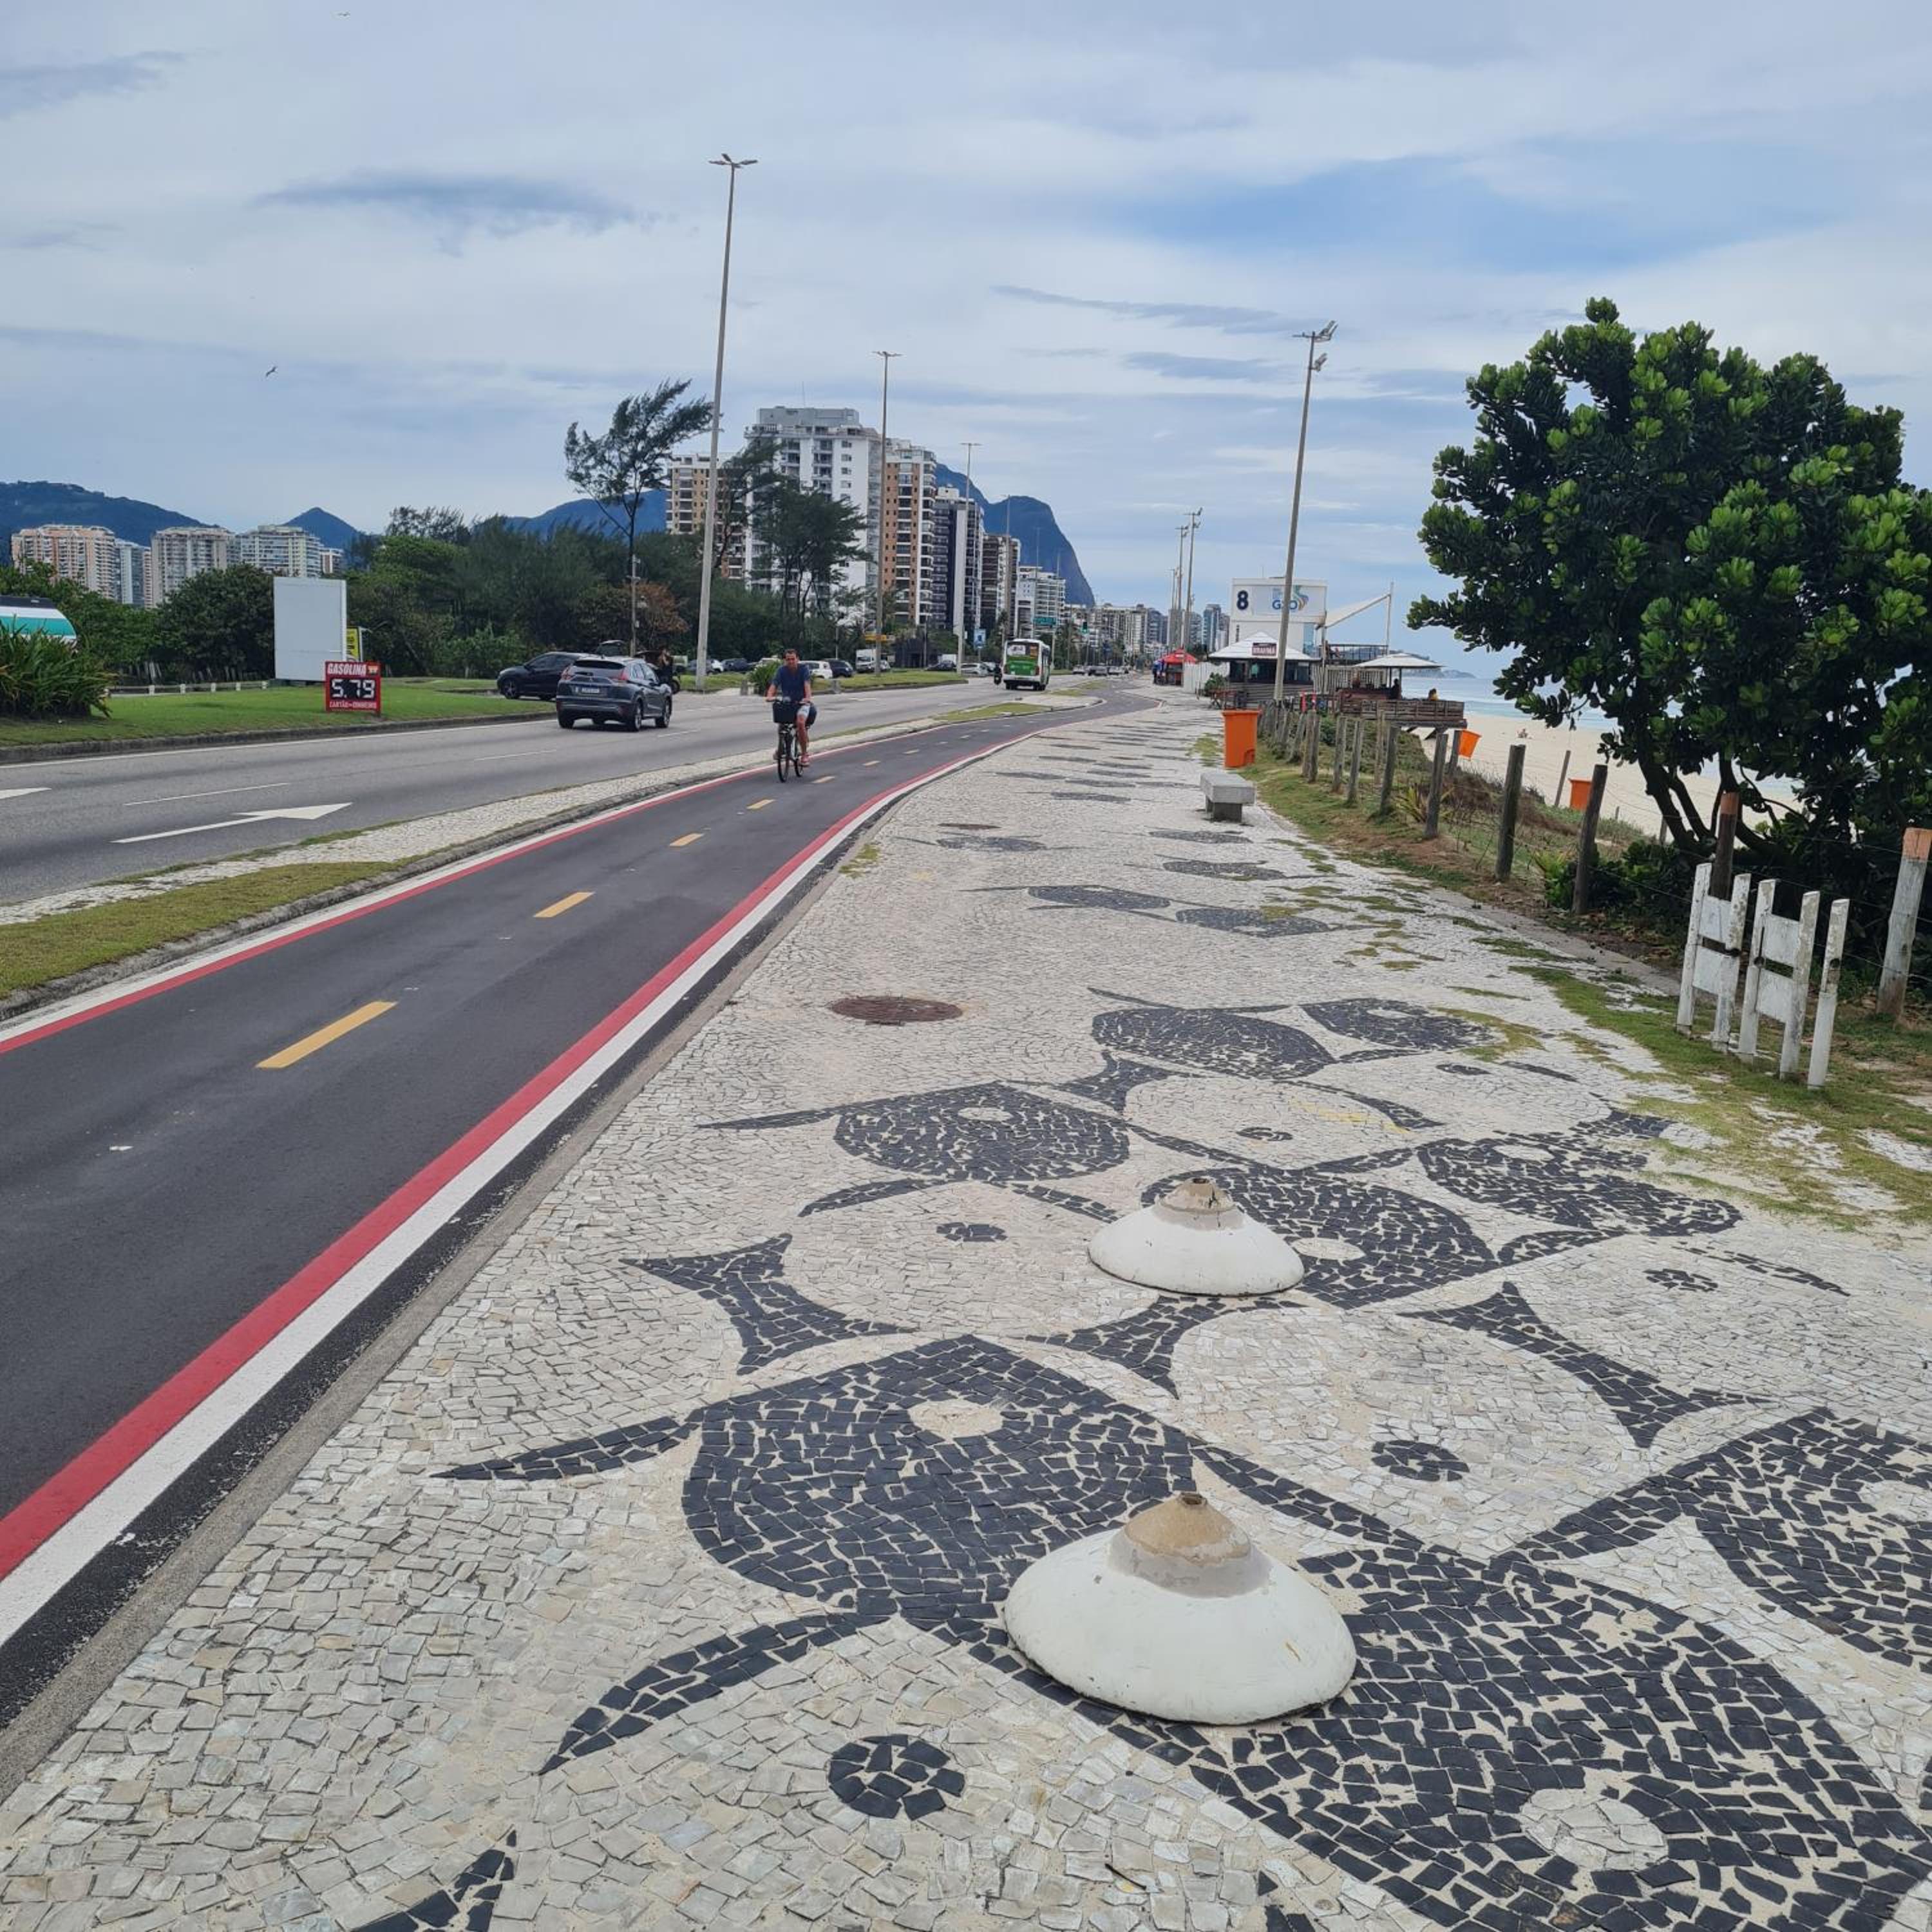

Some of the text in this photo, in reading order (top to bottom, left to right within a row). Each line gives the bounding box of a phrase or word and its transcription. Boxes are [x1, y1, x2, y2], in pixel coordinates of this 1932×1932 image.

[1236, 589, 1249, 611] 8
[1272, 600, 1298, 610] G0
[327, 663, 366, 676] GASOLINA
[332, 678, 375, 699] 5.79
